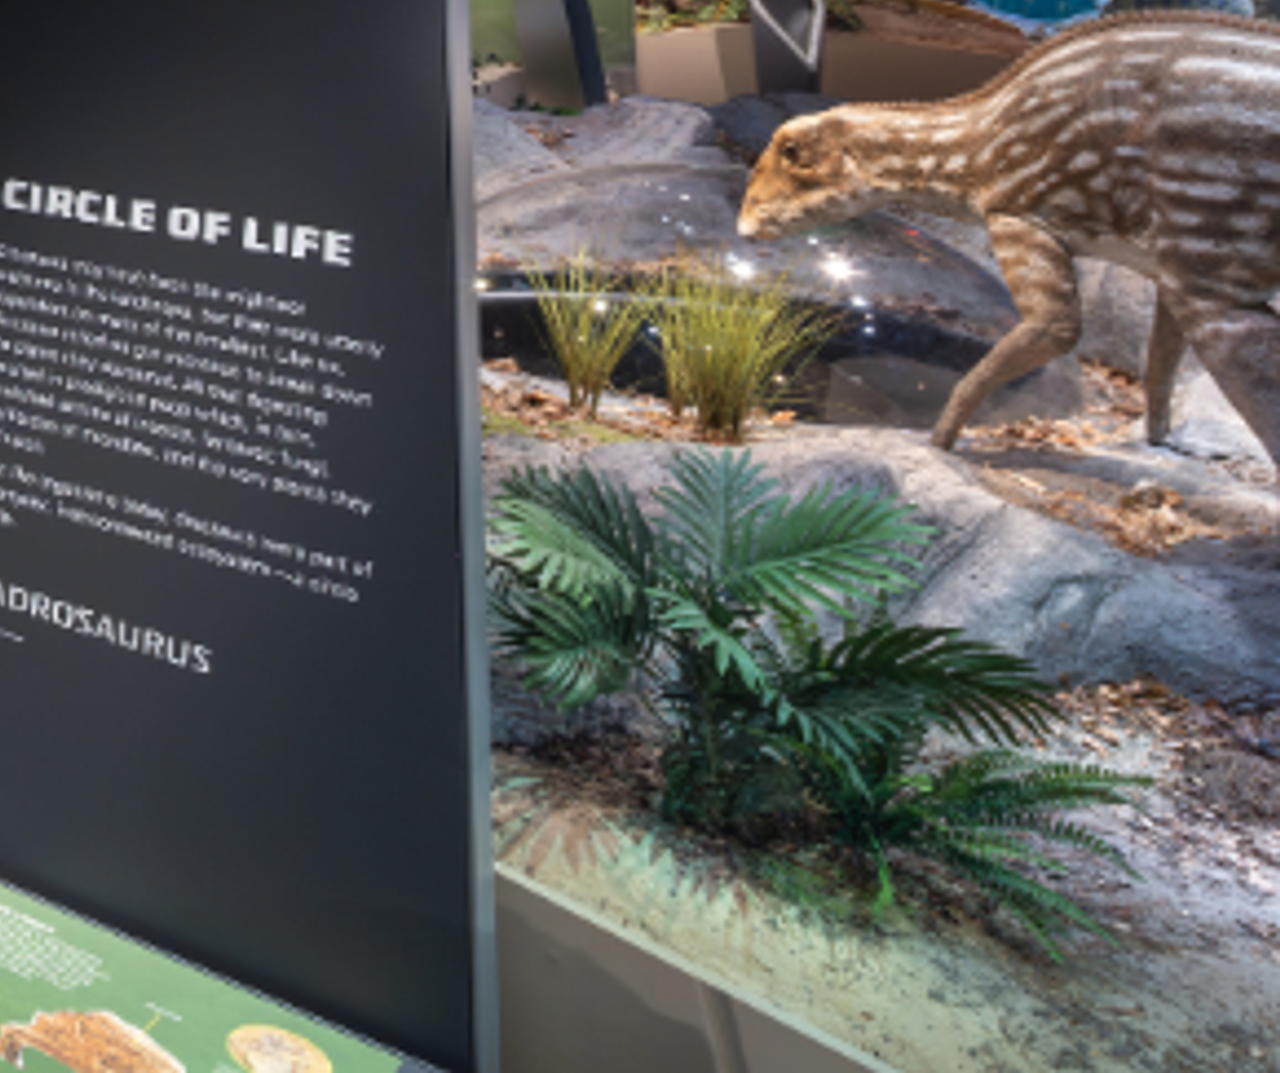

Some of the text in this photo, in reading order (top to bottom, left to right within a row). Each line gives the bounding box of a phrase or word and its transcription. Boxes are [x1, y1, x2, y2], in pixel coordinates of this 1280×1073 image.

[1, 178, 156, 232] CIRCLE
[166, 206, 232, 244] OF
[241, 216, 355, 268] LIFE
